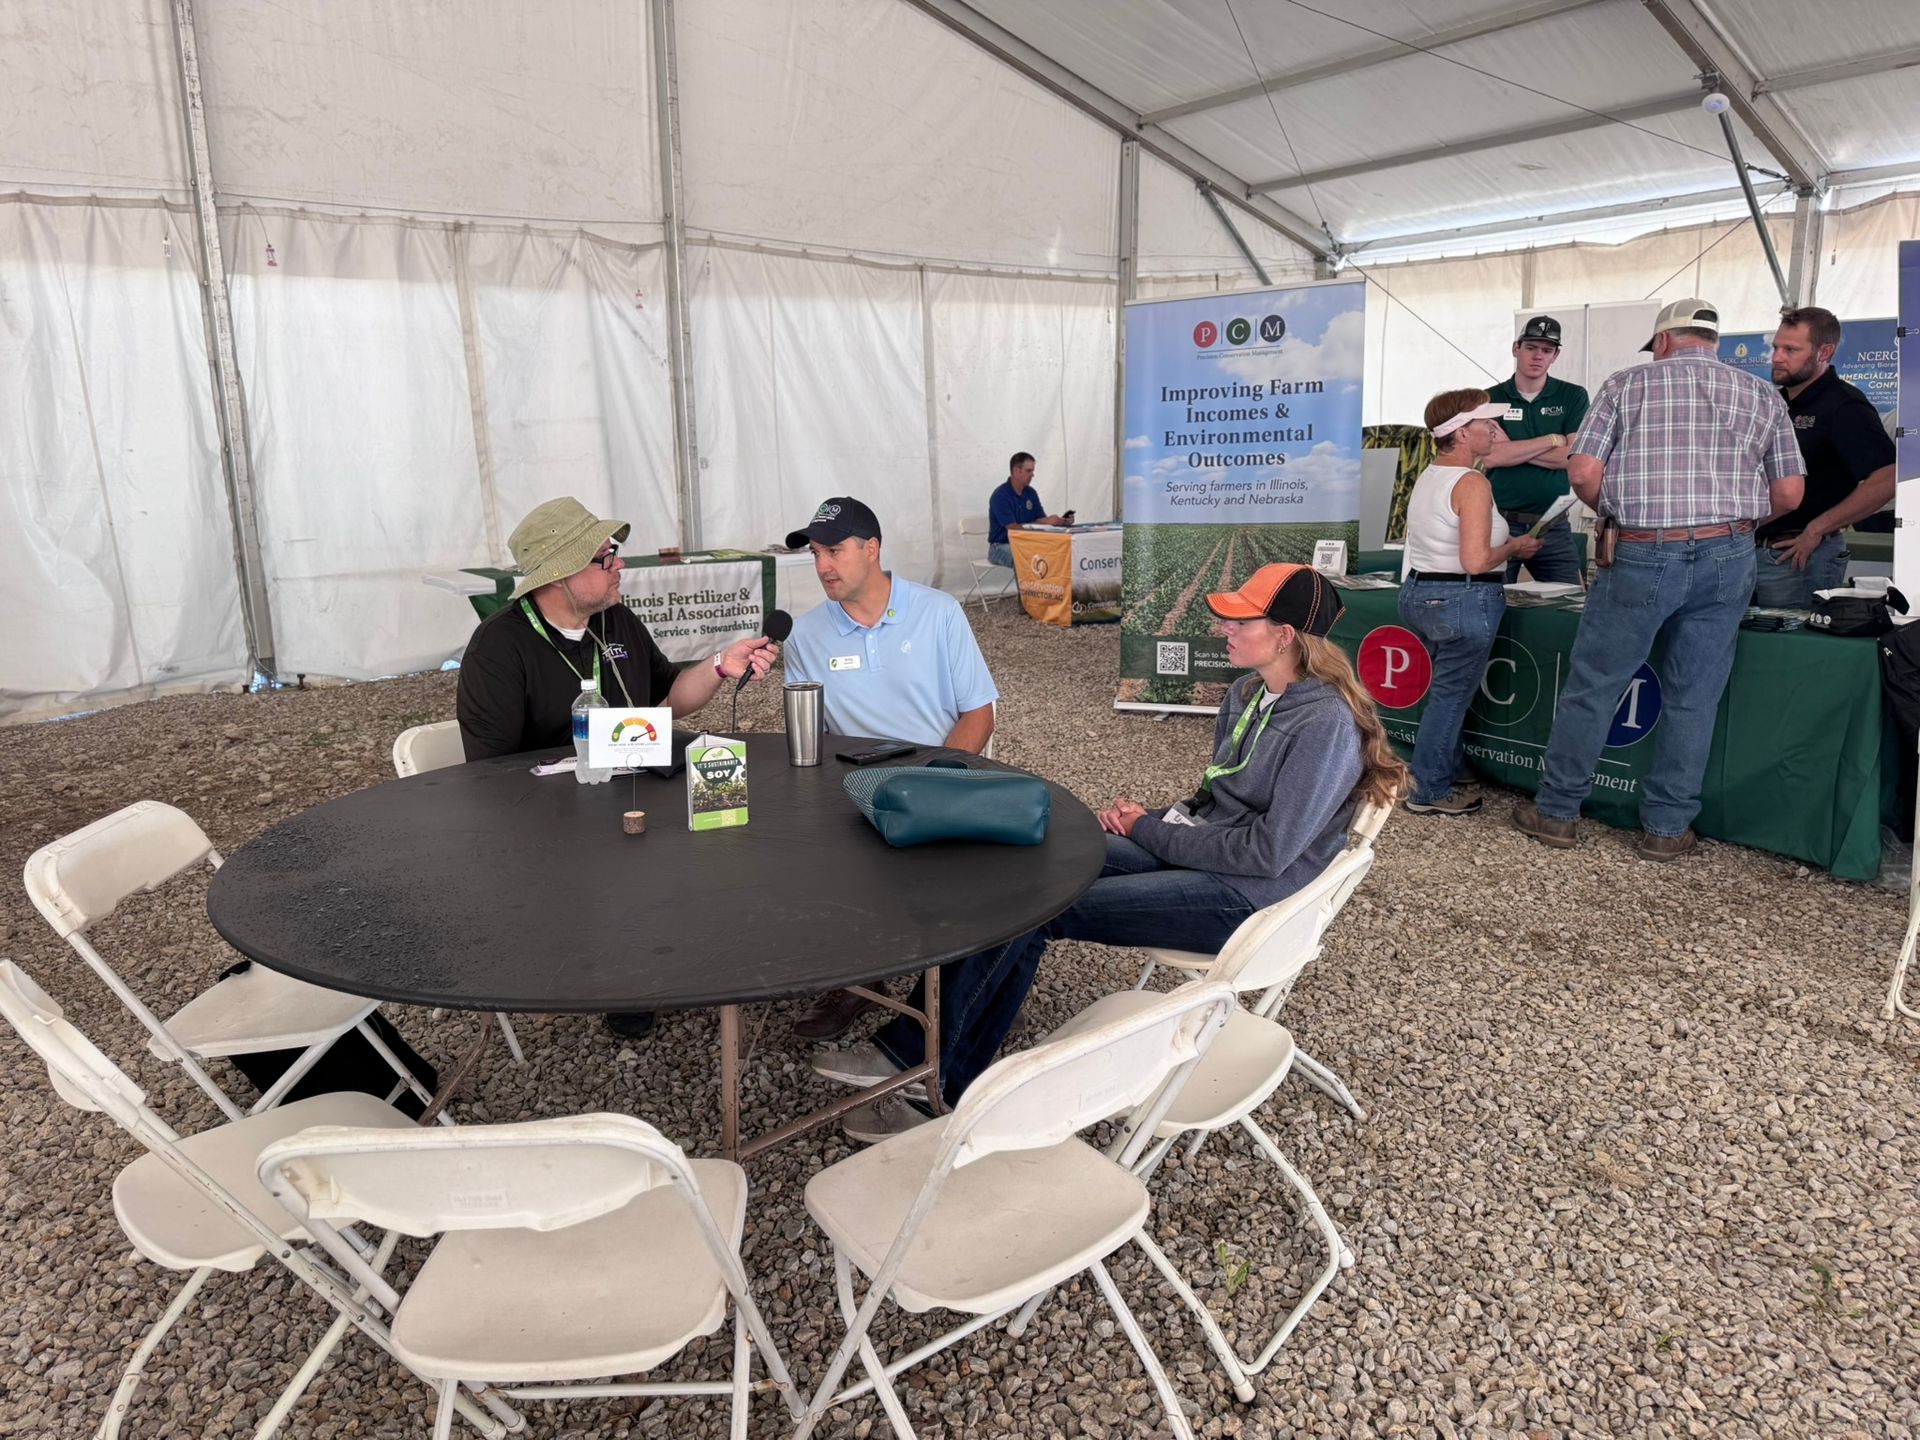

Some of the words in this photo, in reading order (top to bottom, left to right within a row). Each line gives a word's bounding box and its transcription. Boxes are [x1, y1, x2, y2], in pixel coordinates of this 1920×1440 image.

[1200, 327, 1211, 343] P
[1231, 323, 1245, 340] C
[1263, 320, 1282, 338] M
[1857, 350, 1899, 362] NCERC
[1839, 371, 1898, 381] MMERCIALIZA
[1160, 382, 1264, 405] Improving
[1269, 379, 1324, 396] Farm
[1186, 407, 1269, 424] Incomes
[1275, 403, 1290, 419] &
[1164, 423, 1314, 447] Environmental
[1188, 451, 1286, 468] Outcomes
[1165, 481, 1207, 495] Serving
[1210, 480, 1253, 492] farmers
[1255, 480, 1266, 491] in
[1269, 479, 1309, 492] Illinois,
[1170, 495, 1221, 508] Kentucky
[1223, 494, 1246, 505] and
[1248, 493, 1304, 505] Nebraska
[621, 592, 664, 608] linois
[667, 590, 737, 606] Fertilizer
[738, 587, 751, 601] &
[676, 602, 760, 621] Association
[653, 626, 690, 639] Service
[699, 618, 760, 635] Stewardship
[1379, 645, 1410, 689] P
[1481, 657, 1517, 706] C
[1386, 728, 1416, 745] ecisi
[1462, 742, 1534, 769] servation
[706, 769, 731, 780] SOY
